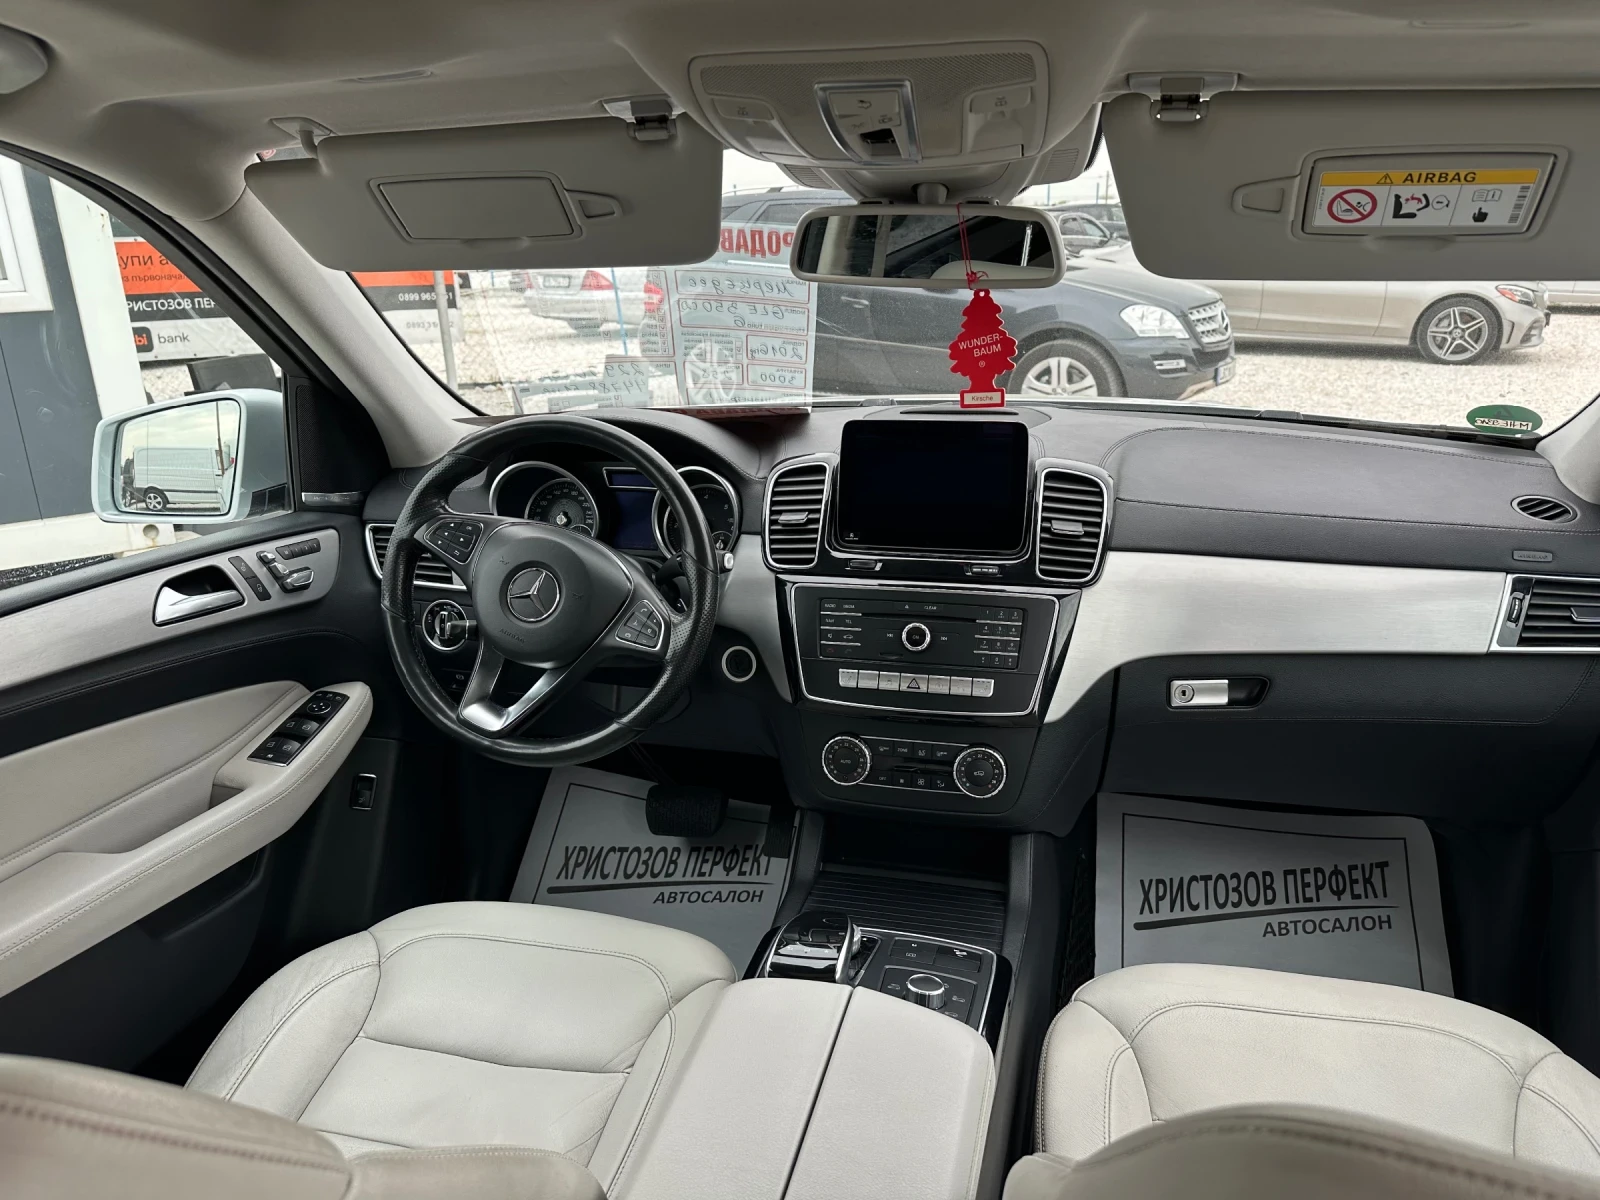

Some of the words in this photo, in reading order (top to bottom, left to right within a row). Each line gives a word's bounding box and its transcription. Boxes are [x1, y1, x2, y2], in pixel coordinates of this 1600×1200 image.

[1402, 171, 1477, 184] AIRBAG
[398, 292, 419, 301] 0899
[157, 332, 190, 345] bank
[958, 333, 1004, 350] WUNDER-
[973, 343, 1002, 358] BAUM
[555, 844, 682, 881] ХРИСТОЗОВ
[652, 888, 765, 905] АВТОСАЛОН
[1138, 869, 1277, 916] ХРИСТОЗОВ
[1283, 860, 1390, 905] ПЕРФЕКТ
[1262, 914, 1394, 938] АВТОСАЛОН
